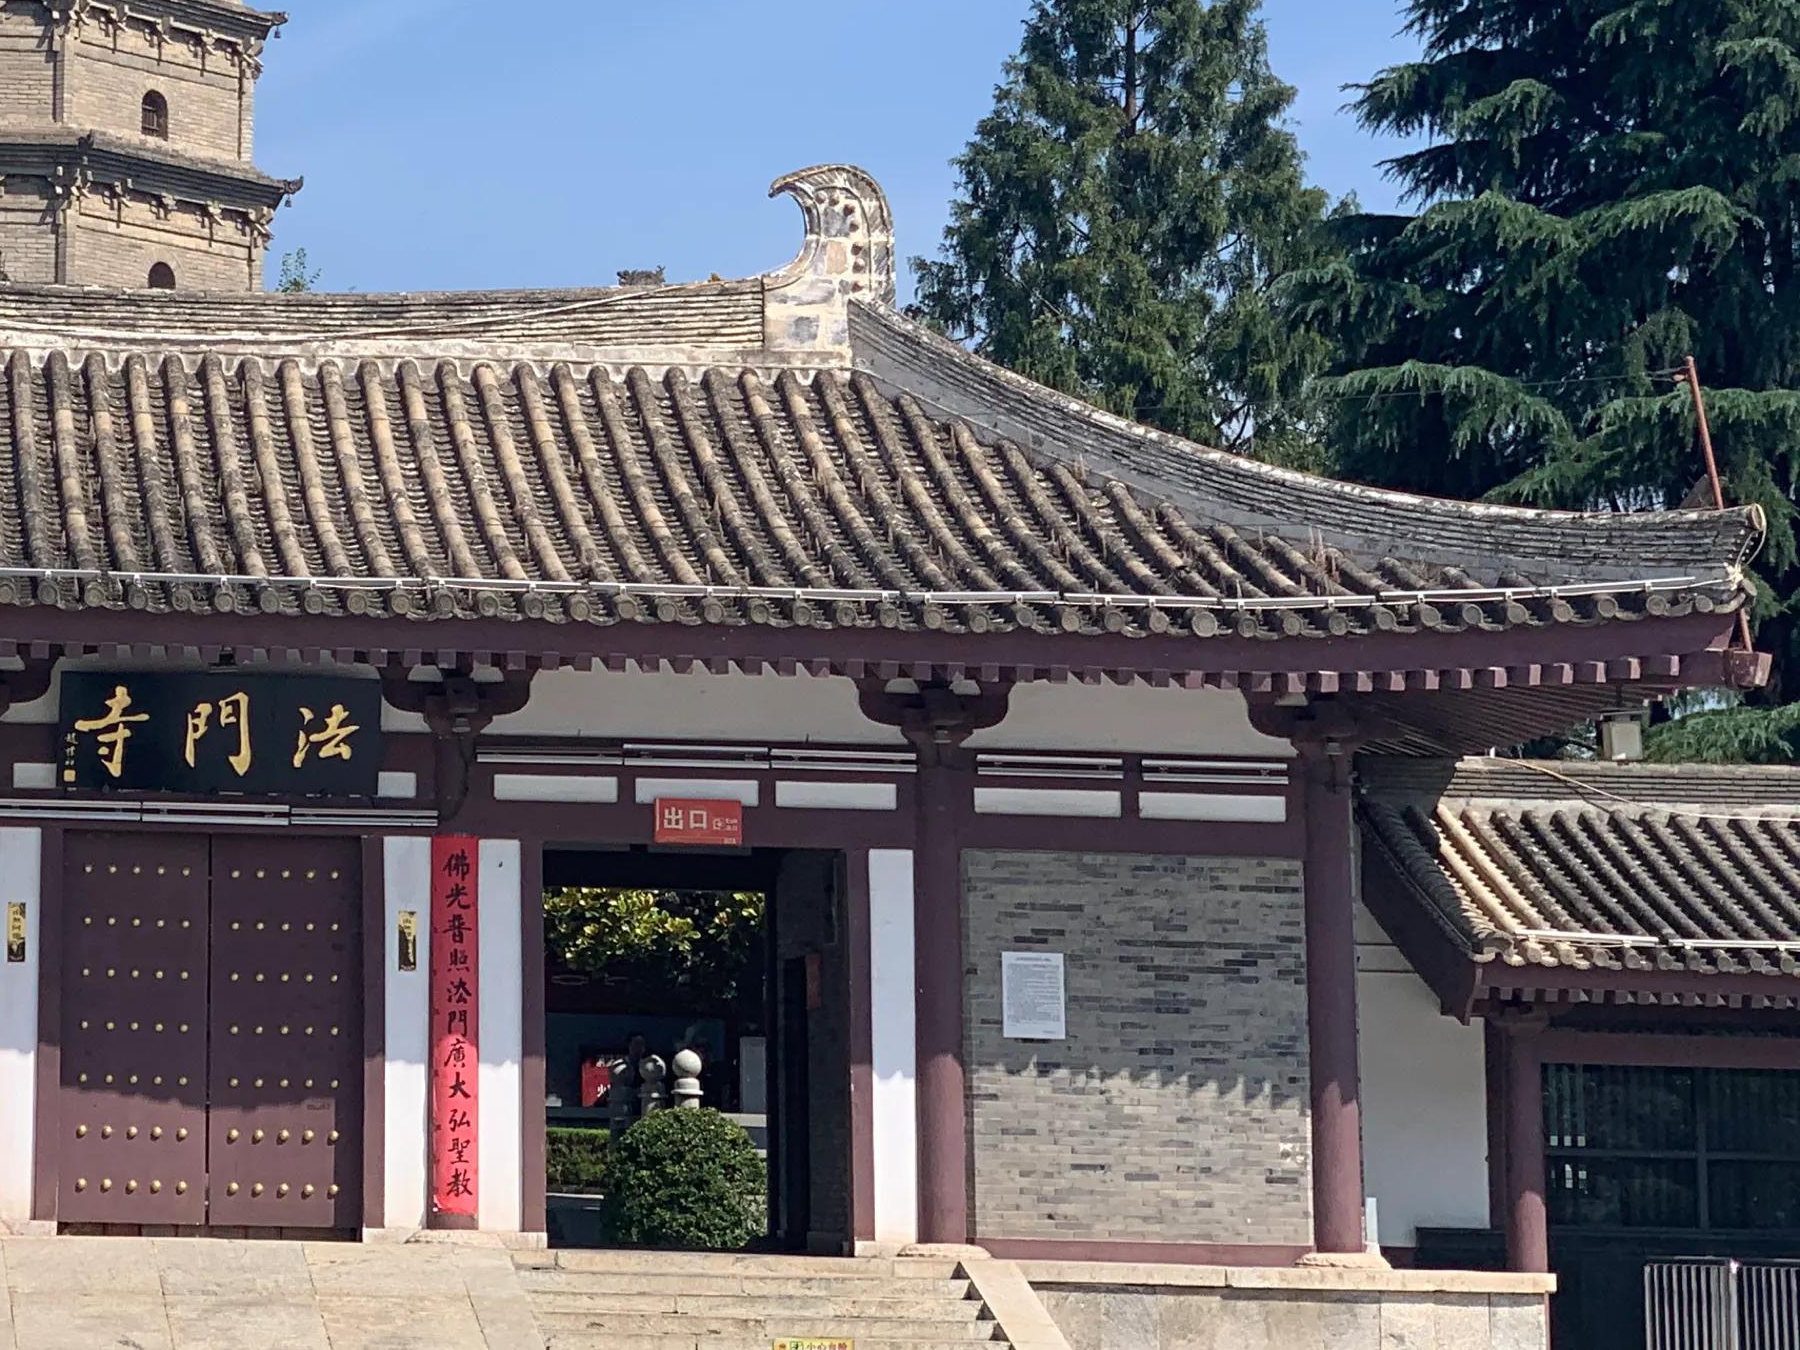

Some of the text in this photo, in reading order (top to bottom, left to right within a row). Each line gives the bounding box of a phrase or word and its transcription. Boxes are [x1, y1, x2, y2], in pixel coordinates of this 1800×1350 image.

[75, 685, 360, 778] 法門寺
[663, 806, 707, 830] 出口
